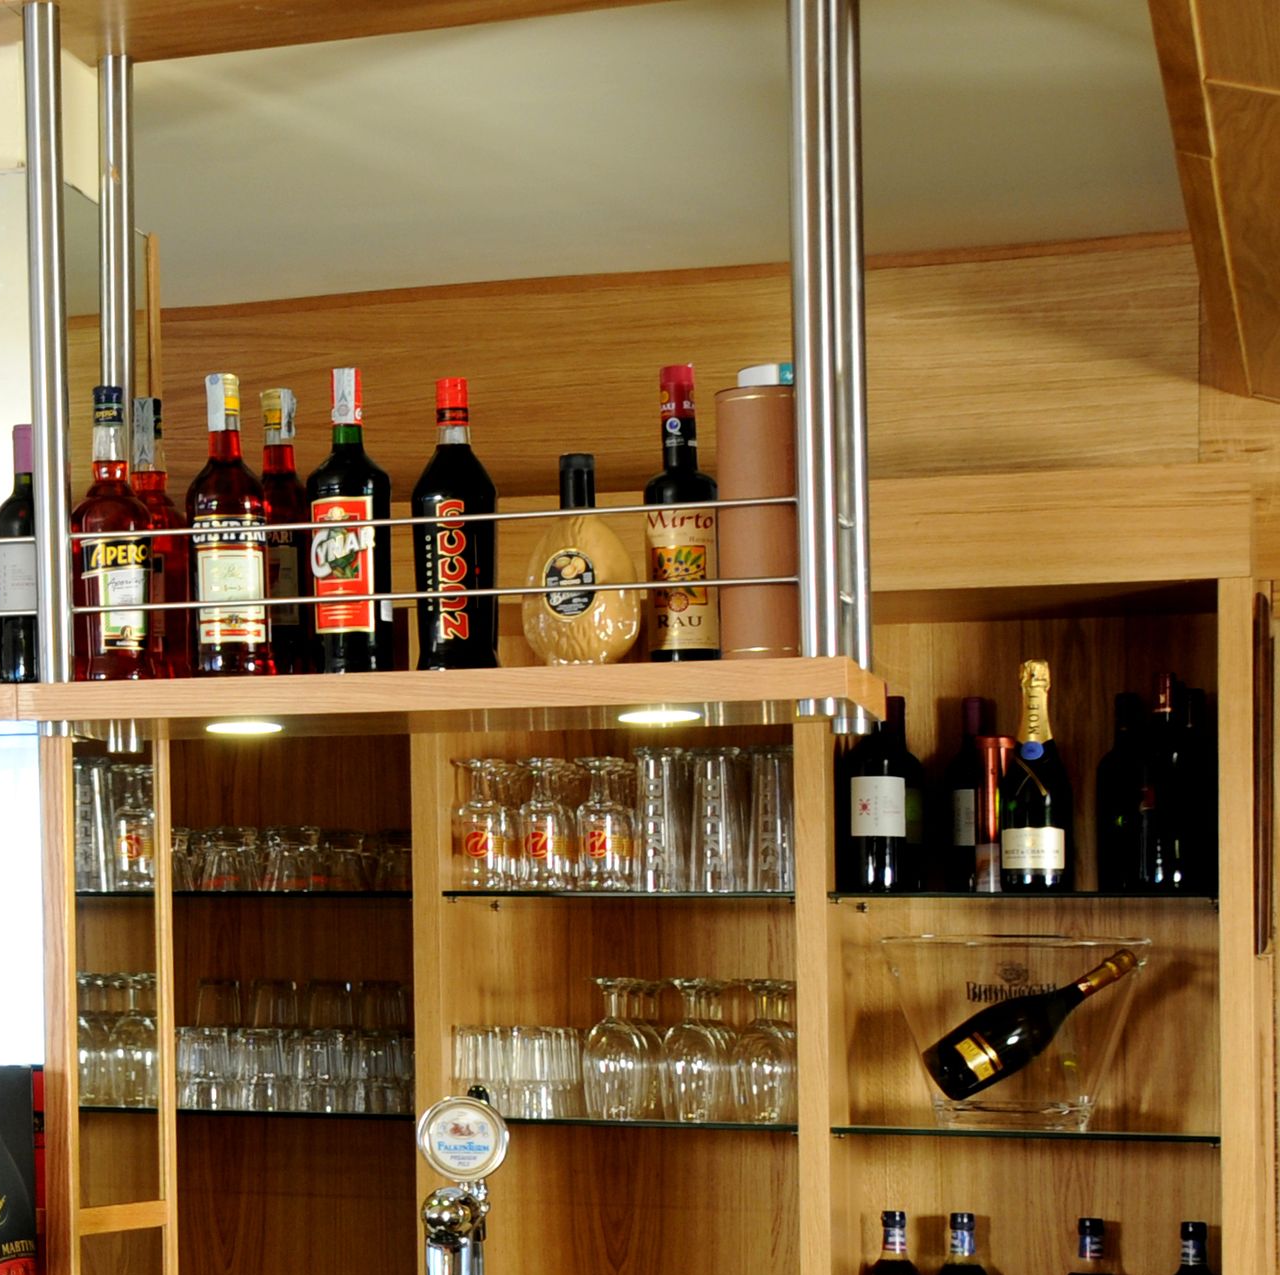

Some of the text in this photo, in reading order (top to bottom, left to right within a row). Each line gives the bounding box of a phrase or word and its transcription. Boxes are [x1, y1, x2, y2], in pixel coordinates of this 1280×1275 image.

[647, 509, 713, 530] Mirto
[193, 520, 266, 543] CAMPARI
[91, 544, 148, 568] APERO
[311, 525, 375, 578] CYNAR
[436, 499, 469, 640] ZUCCA
[657, 614, 702, 628] RAU
[1, 1239, 34, 1255] MARTIN
